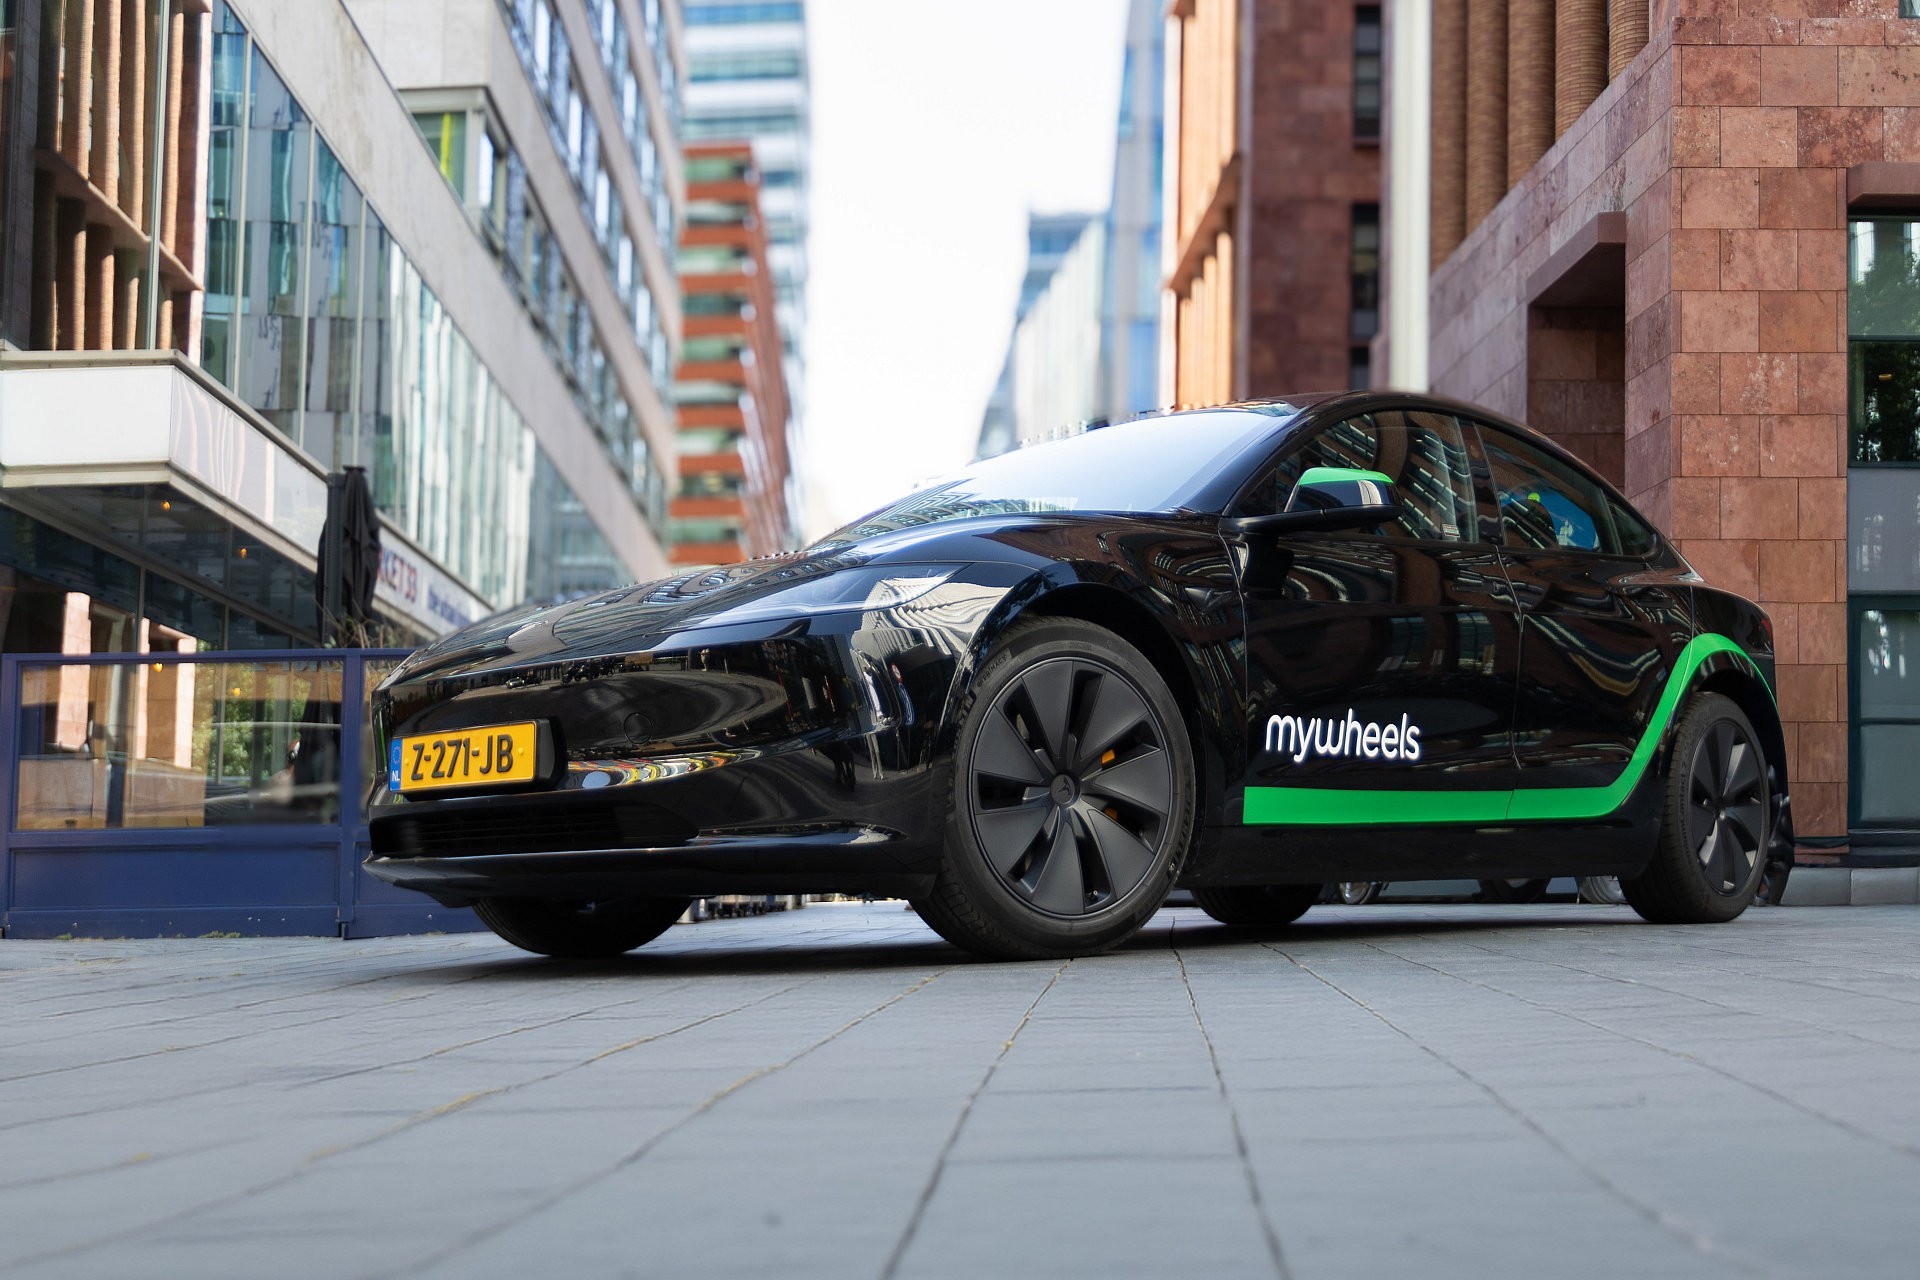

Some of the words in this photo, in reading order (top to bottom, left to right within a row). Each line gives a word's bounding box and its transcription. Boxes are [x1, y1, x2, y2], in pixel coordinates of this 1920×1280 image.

[411, 734, 513, 781] Z-271-JB
[1265, 708, 1420, 763] mywheels
[392, 770, 400, 781] NL
